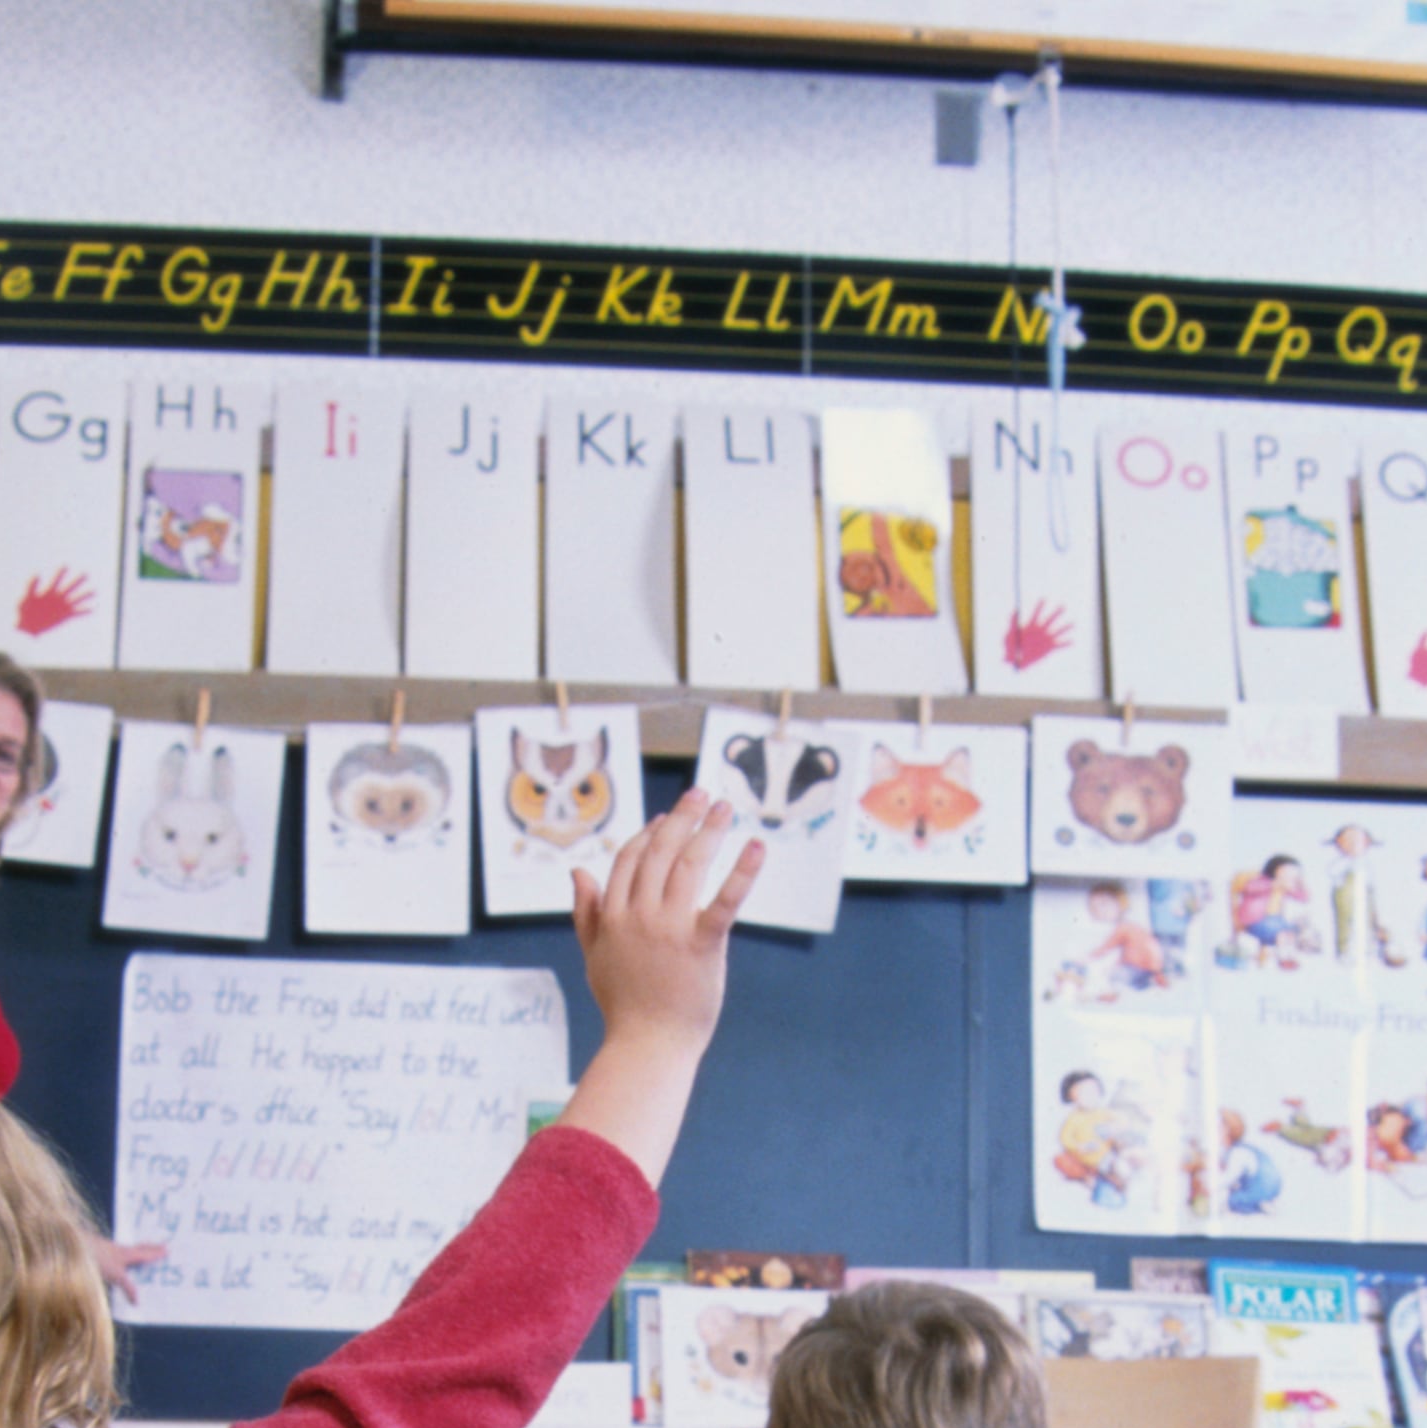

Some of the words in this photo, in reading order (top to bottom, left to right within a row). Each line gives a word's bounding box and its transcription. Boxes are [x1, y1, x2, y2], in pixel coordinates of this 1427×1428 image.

[53, 242, 145, 302] Ff
[160, 245, 243, 333] Gg
[256, 250, 361, 312] Hh
[387, 255, 454, 316] Ii
[486, 260, 571, 346] Jj
[596, 264, 683, 326] Kk
[722, 270, 792, 332] Ll
[819, 275, 942, 339] Mm
[1128, 293, 1207, 354] Oo
[1236, 299, 1313, 383] Pp
[1336, 305, 1422, 392] Qq
[11, 389, 109, 461] Gg
[155, 384, 237, 431] Hh
[323, 400, 359, 459] Ii
[448, 403, 501, 474] Jj
[577, 411, 647, 468] Kk
[724, 414, 776, 465] Ll
[1117, 436, 1210, 491] Oo
[1253, 434, 1320, 493] Pp
[132, 972, 193, 1014] Bob
[213, 976, 259, 1016] the
[278, 976, 340, 1032] Frog
[130, 1031, 161, 1065] at
[251, 1031, 288, 1070] He
[401, 1041, 428, 1075] to
[437, 1040, 481, 1078] the
[128, 1133, 190, 1191] Frog
[194, 1193, 252, 1235] head
[349, 1208, 402, 1239] and
[193, 1268, 210, 1289] a
[1230, 1283, 1337, 1313] POLAR
